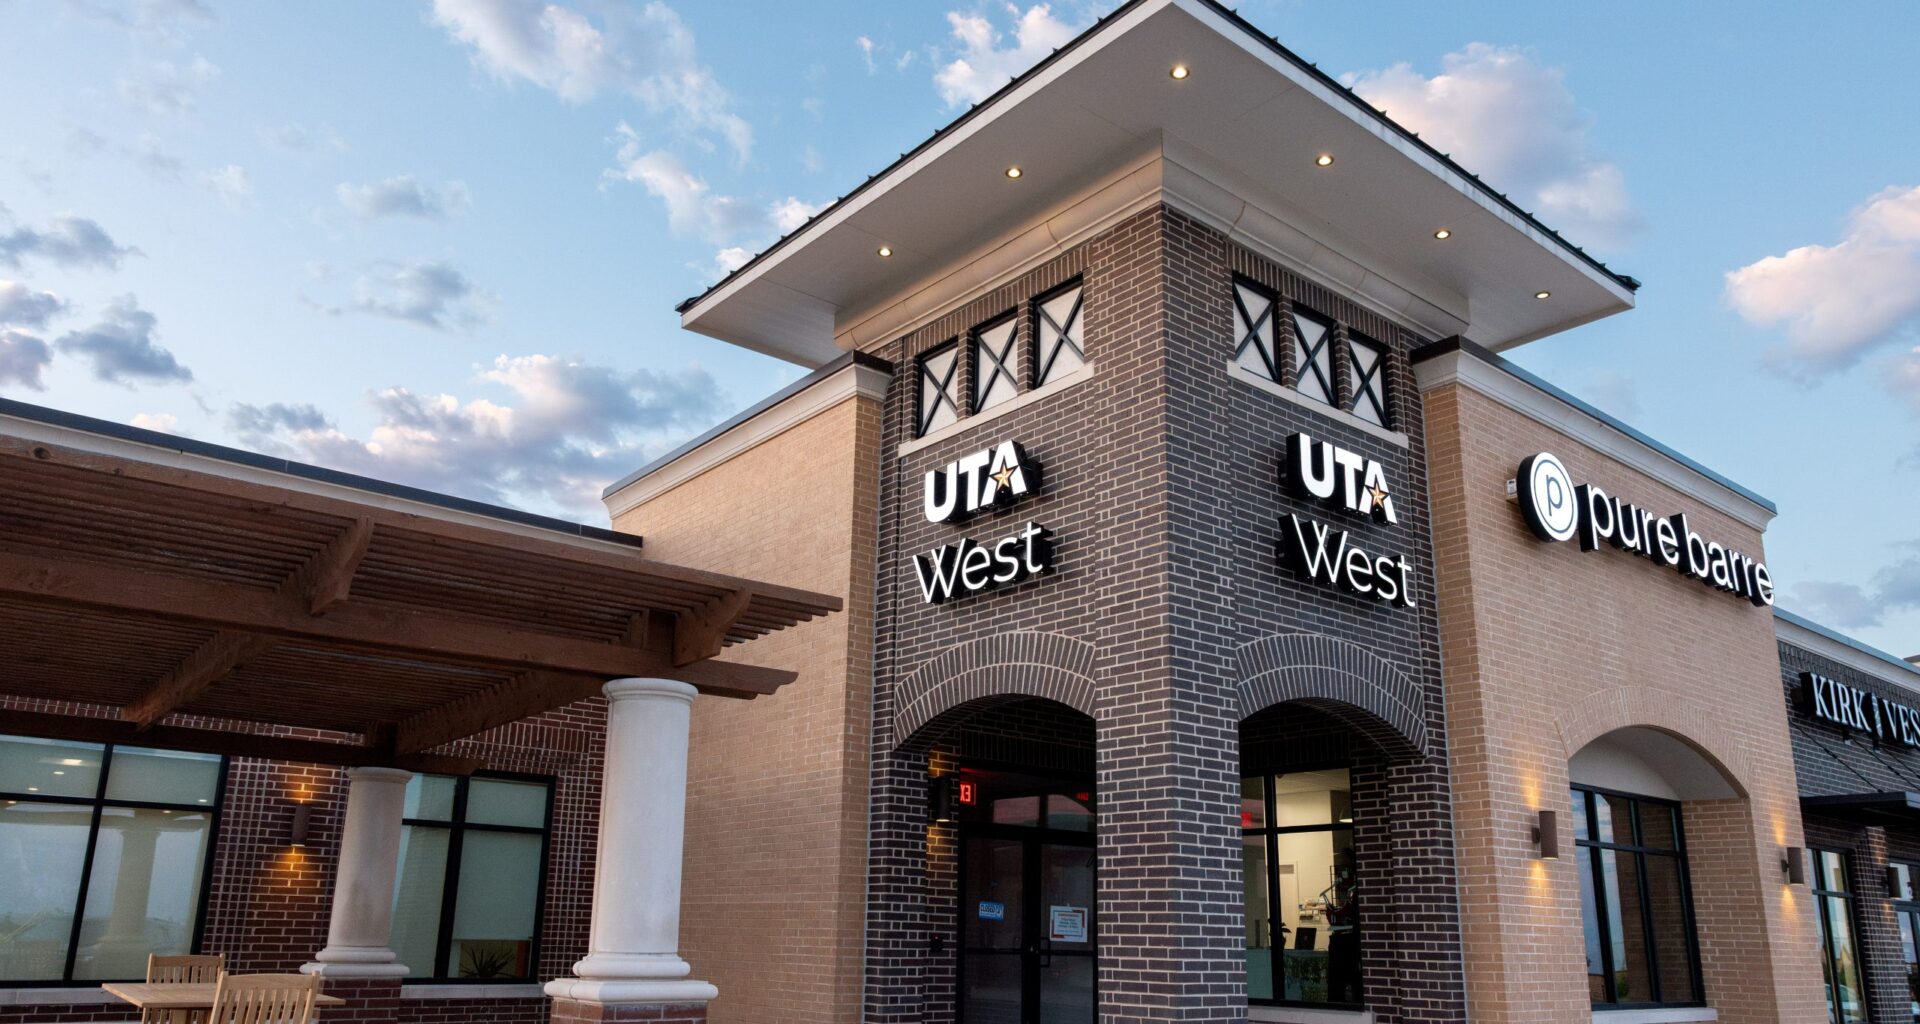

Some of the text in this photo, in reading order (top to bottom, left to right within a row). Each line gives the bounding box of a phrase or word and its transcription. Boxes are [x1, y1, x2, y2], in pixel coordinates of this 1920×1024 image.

[924, 439, 1028, 524] UTA
[1299, 432, 1398, 525] UTA
[912, 521, 1044, 604] West
[1291, 513, 1416, 608] West
[1586, 483, 1776, 606] pure barre
[1810, 672, 1873, 733] KIRK
